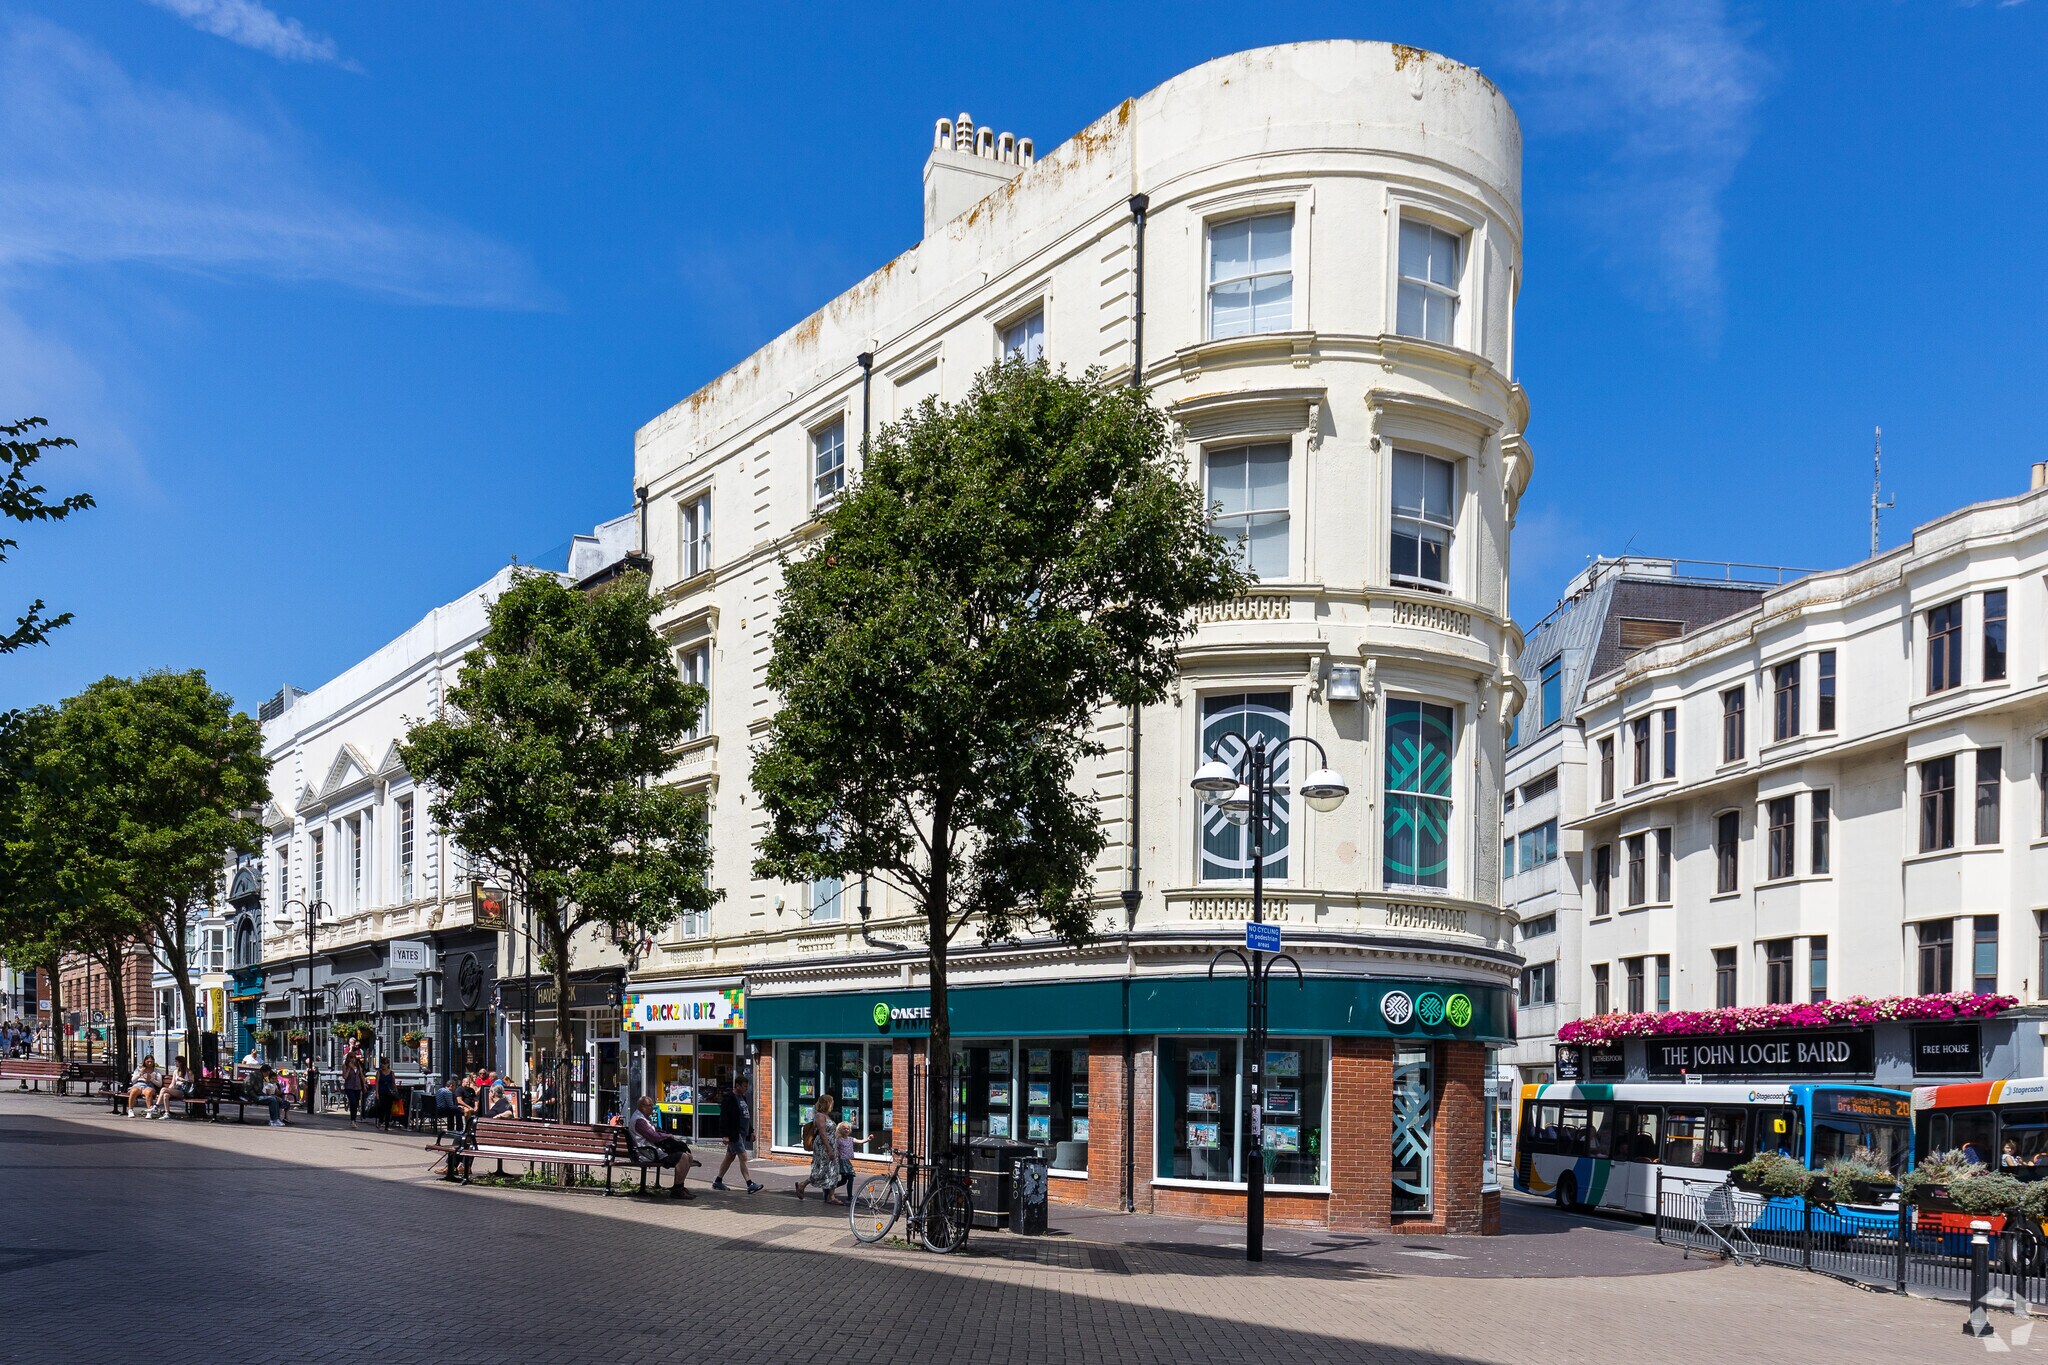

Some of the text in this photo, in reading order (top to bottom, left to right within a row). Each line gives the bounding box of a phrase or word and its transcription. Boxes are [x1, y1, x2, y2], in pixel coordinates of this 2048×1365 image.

[1258, 926, 1278, 935] CYCLING
[398, 950, 418, 960] YATES
[538, 986, 576, 1004] HAVEK
[646, 1002, 716, 1021] BRICKZ N BITZ
[890, 1006, 932, 1020] OAKFIE
[1922, 1044, 1970, 1054] FREE HOUSE
[1662, 1041, 1850, 1068] THE JOHN LOGIE BAIRD
[2012, 1086, 2044, 1095] Stagecoach
[1756, 1092, 1784, 1101] Stagecoach
[1873, 1105, 1891, 1115] Farm
[1896, 1101, 1910, 1116] 20
